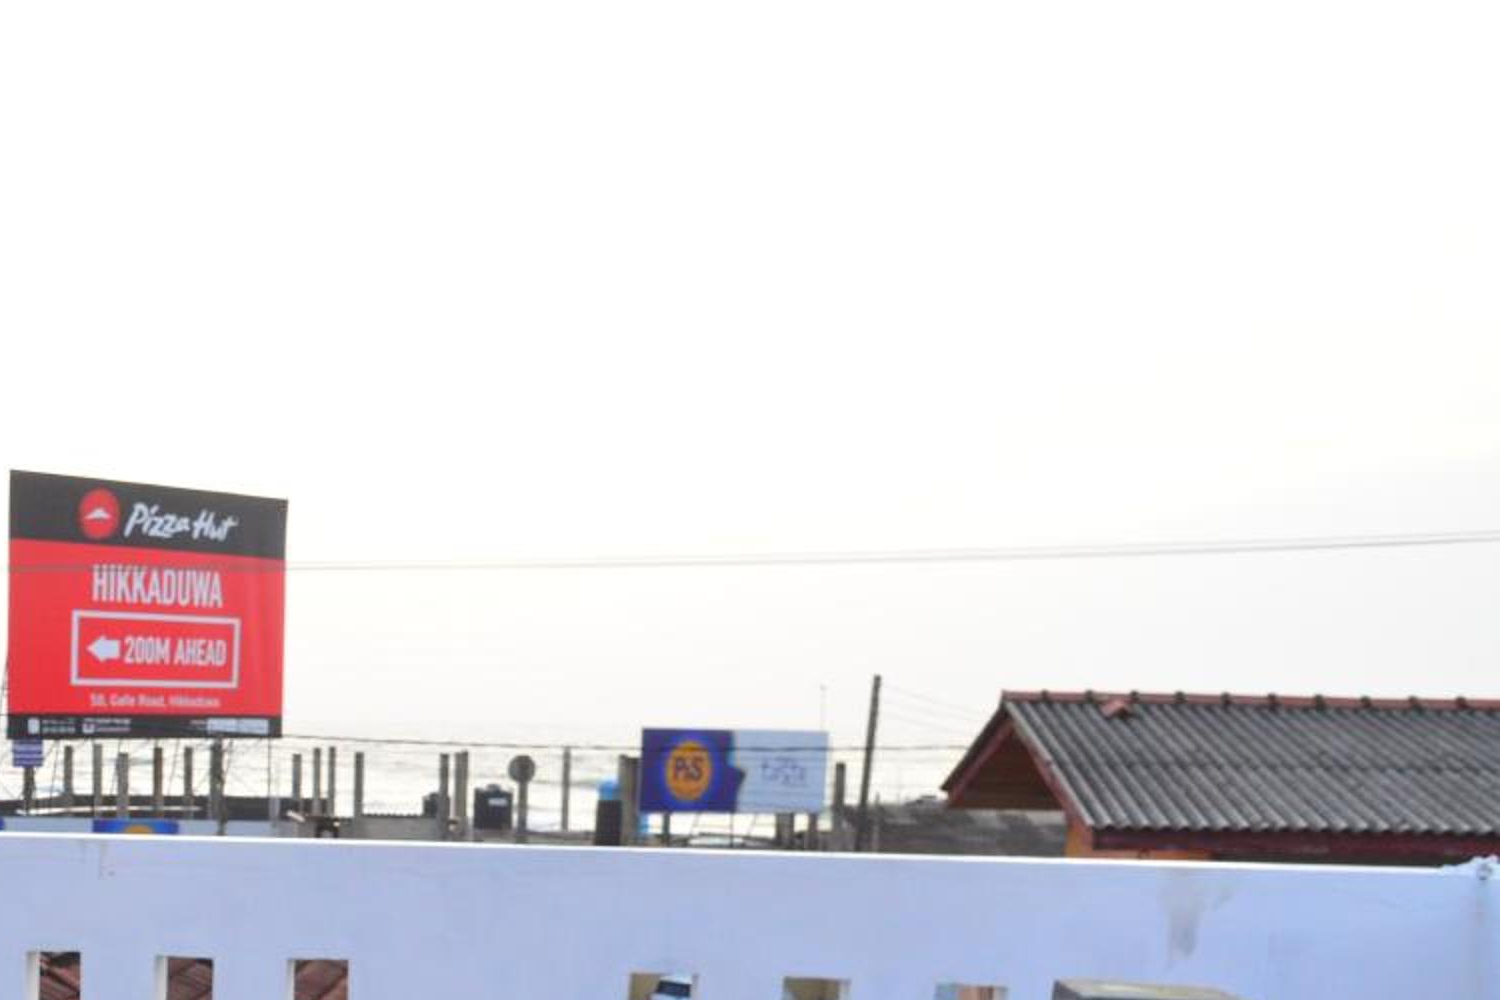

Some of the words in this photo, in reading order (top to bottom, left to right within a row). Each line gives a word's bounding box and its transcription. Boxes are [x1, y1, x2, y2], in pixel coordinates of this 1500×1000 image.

[123, 502, 190, 538] Pizza
[191, 509, 238, 541] Hut
[92, 564, 223, 608] HIKKADUWA
[124, 635, 172, 665] 200M
[174, 637, 227, 666] AHEAD
